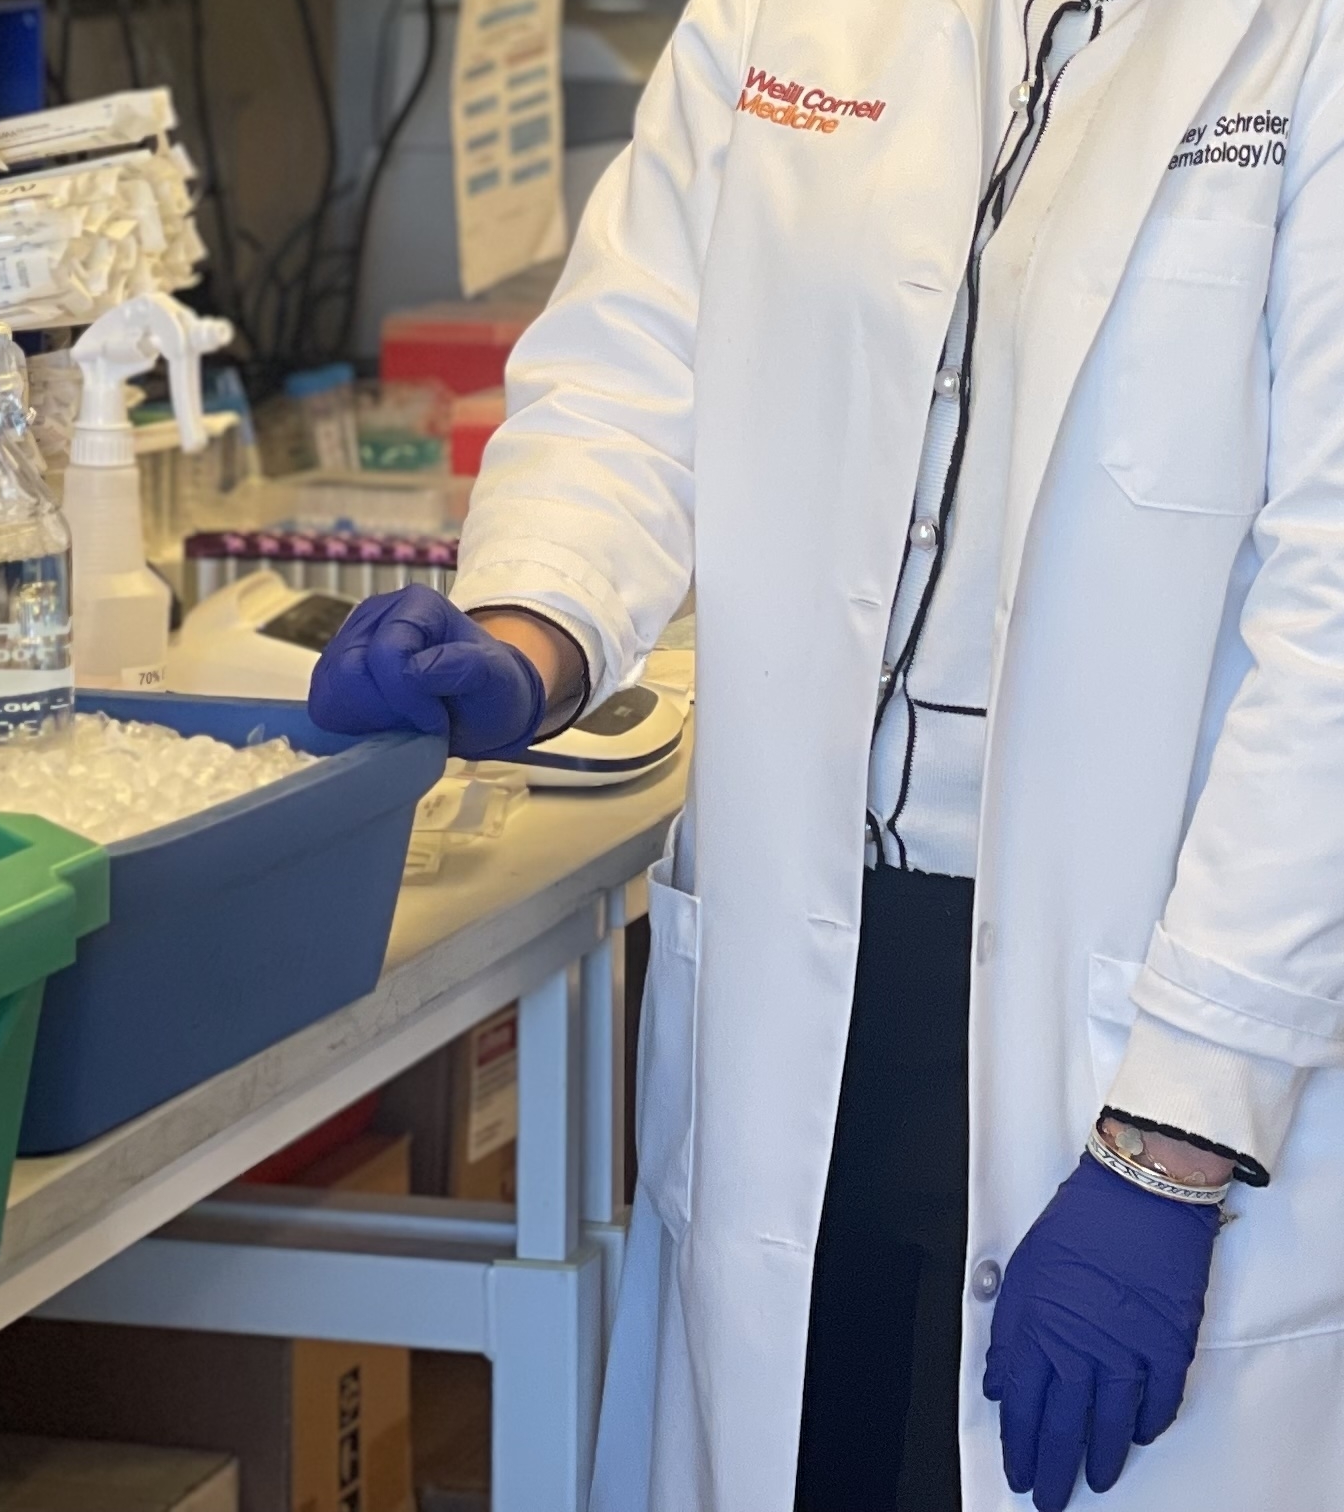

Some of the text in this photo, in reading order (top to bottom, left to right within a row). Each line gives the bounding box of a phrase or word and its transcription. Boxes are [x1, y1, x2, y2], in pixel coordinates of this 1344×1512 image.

[736, 89, 840, 134] Medicine
[745, 65, 887, 123] Weill Cornell
[138, 671, 161, 687] 70%
